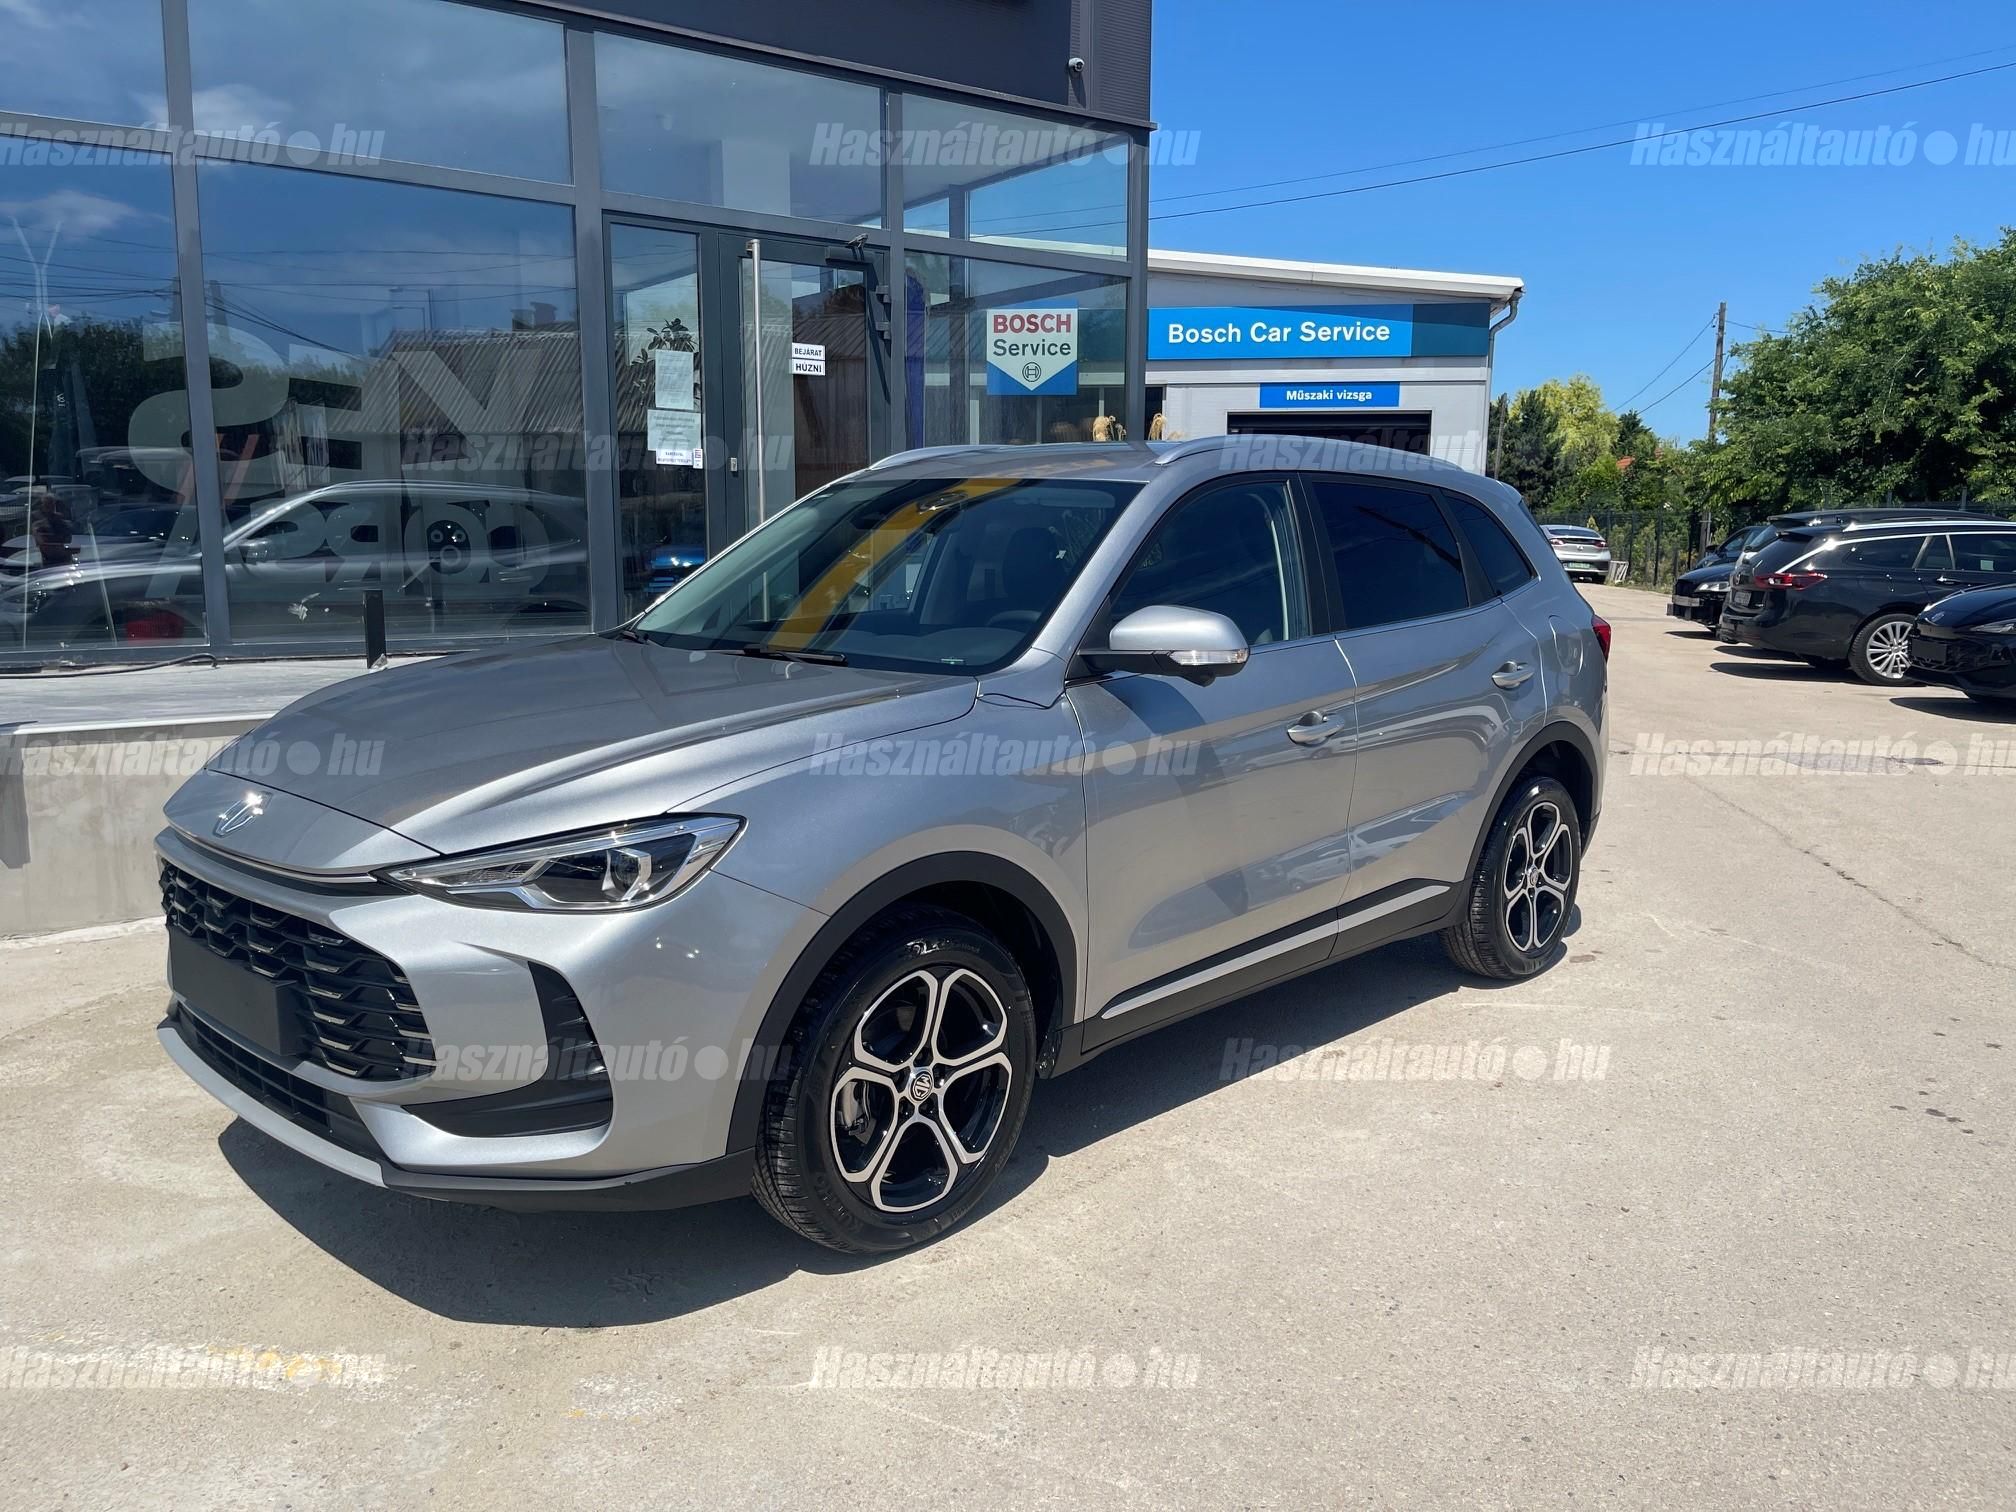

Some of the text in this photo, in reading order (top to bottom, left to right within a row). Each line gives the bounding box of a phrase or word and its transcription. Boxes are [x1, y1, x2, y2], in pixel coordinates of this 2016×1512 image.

[993, 313, 1072, 334] BOSCH
[1168, 320, 1391, 344] Bosch Car Service
[794, 346, 823, 356] BEJÁRAT
[993, 338, 1072, 356] Service
[1286, 389, 1373, 402] Műszaki vizsga
